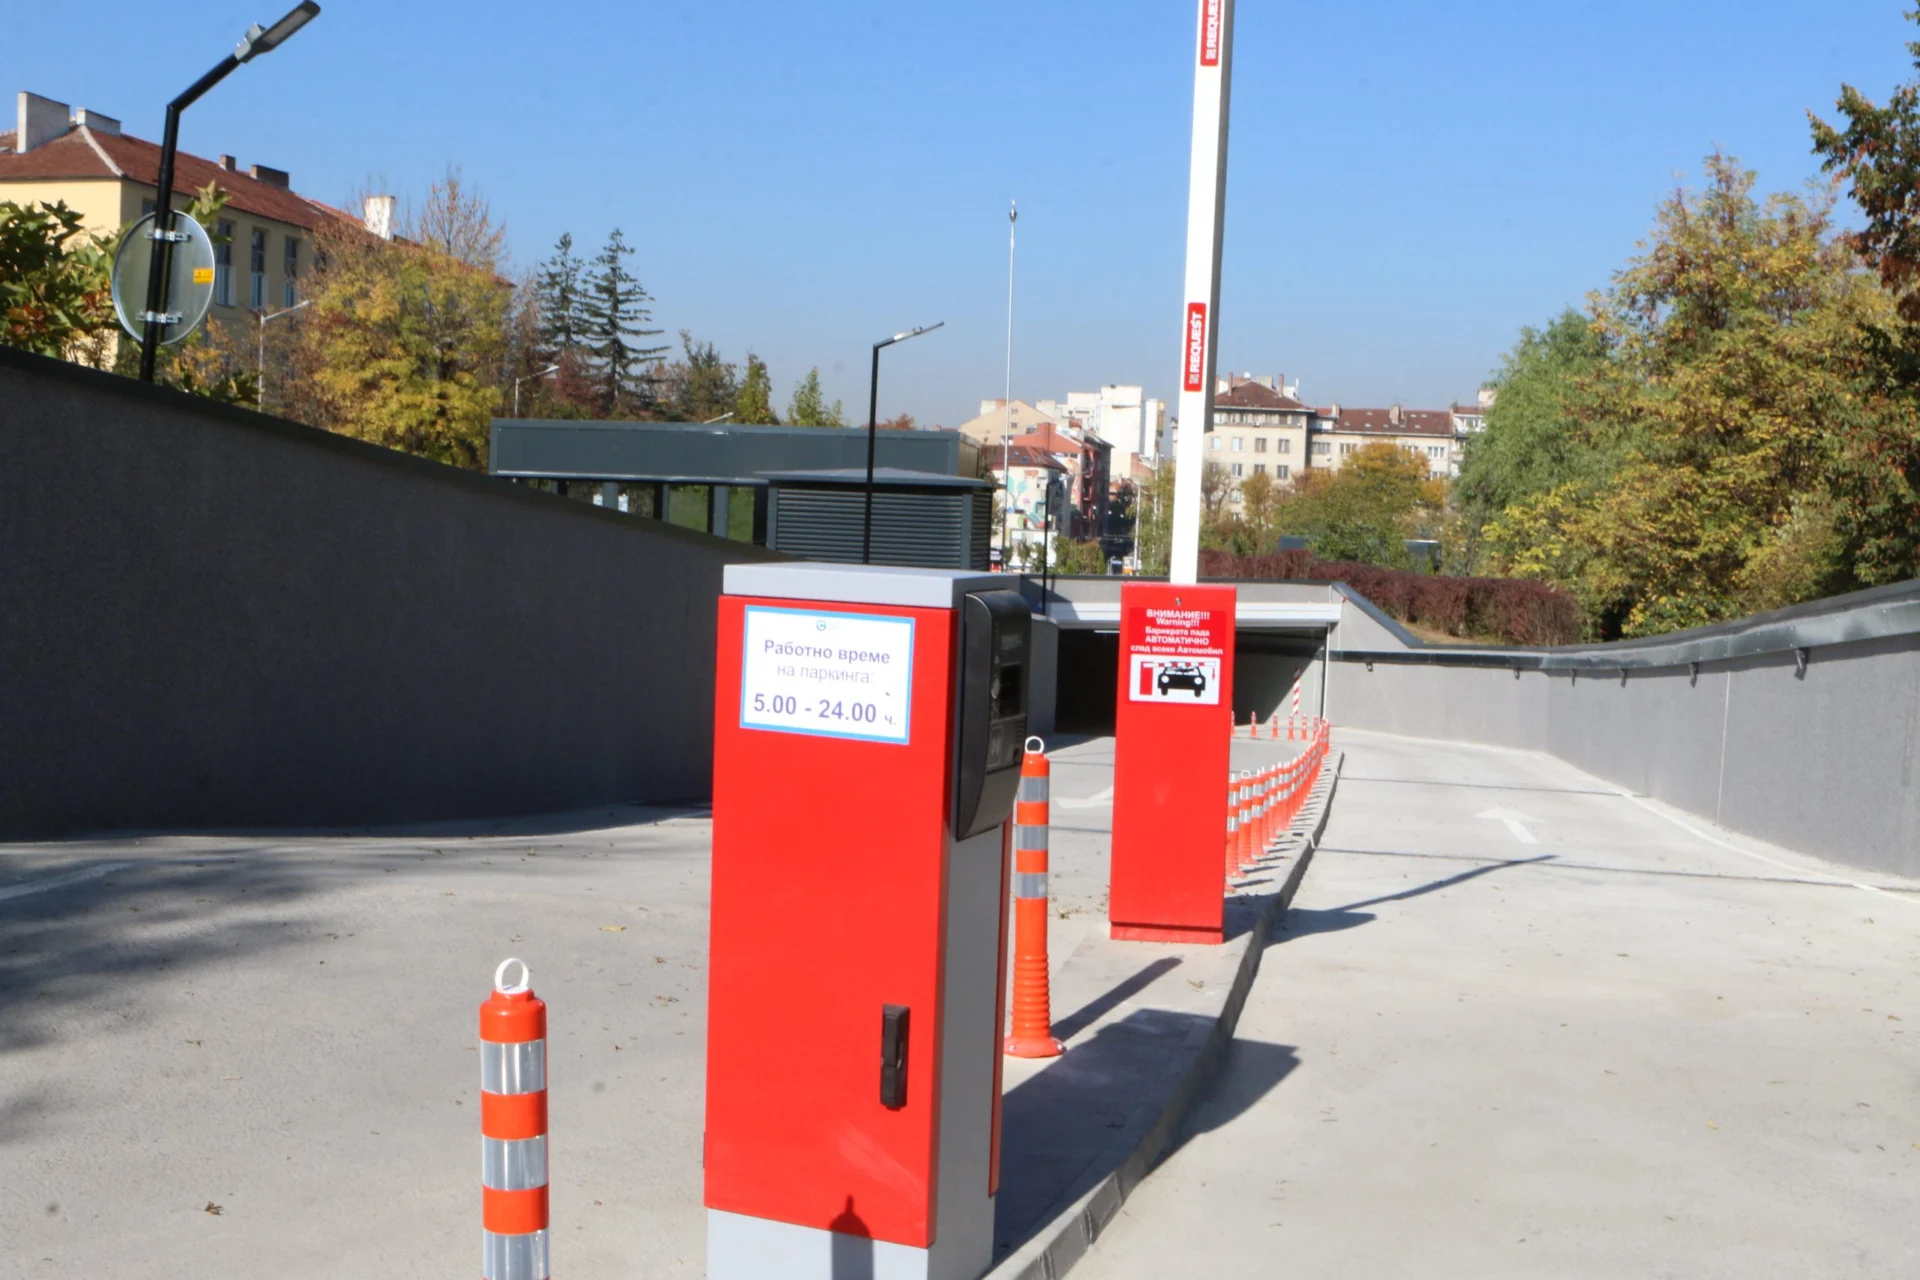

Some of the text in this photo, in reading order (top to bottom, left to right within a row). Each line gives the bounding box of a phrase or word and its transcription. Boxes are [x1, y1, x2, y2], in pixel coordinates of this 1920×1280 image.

[1190, 310, 1202, 373] REQUEST
[1146, 608, 1210, 620] ВНИМАНИЕ!!!
[1156, 617, 1200, 628] Warning!!!
[1145, 635, 1209, 645] АВТОМАТИЧНО
[764, 639, 890, 664] Работно време
[1177, 645, 1223, 655] Автомобил
[777, 664, 874, 685] на паркинга:
[753, 692, 797, 715] 5.00
[818, 699, 877, 723] 24.00
